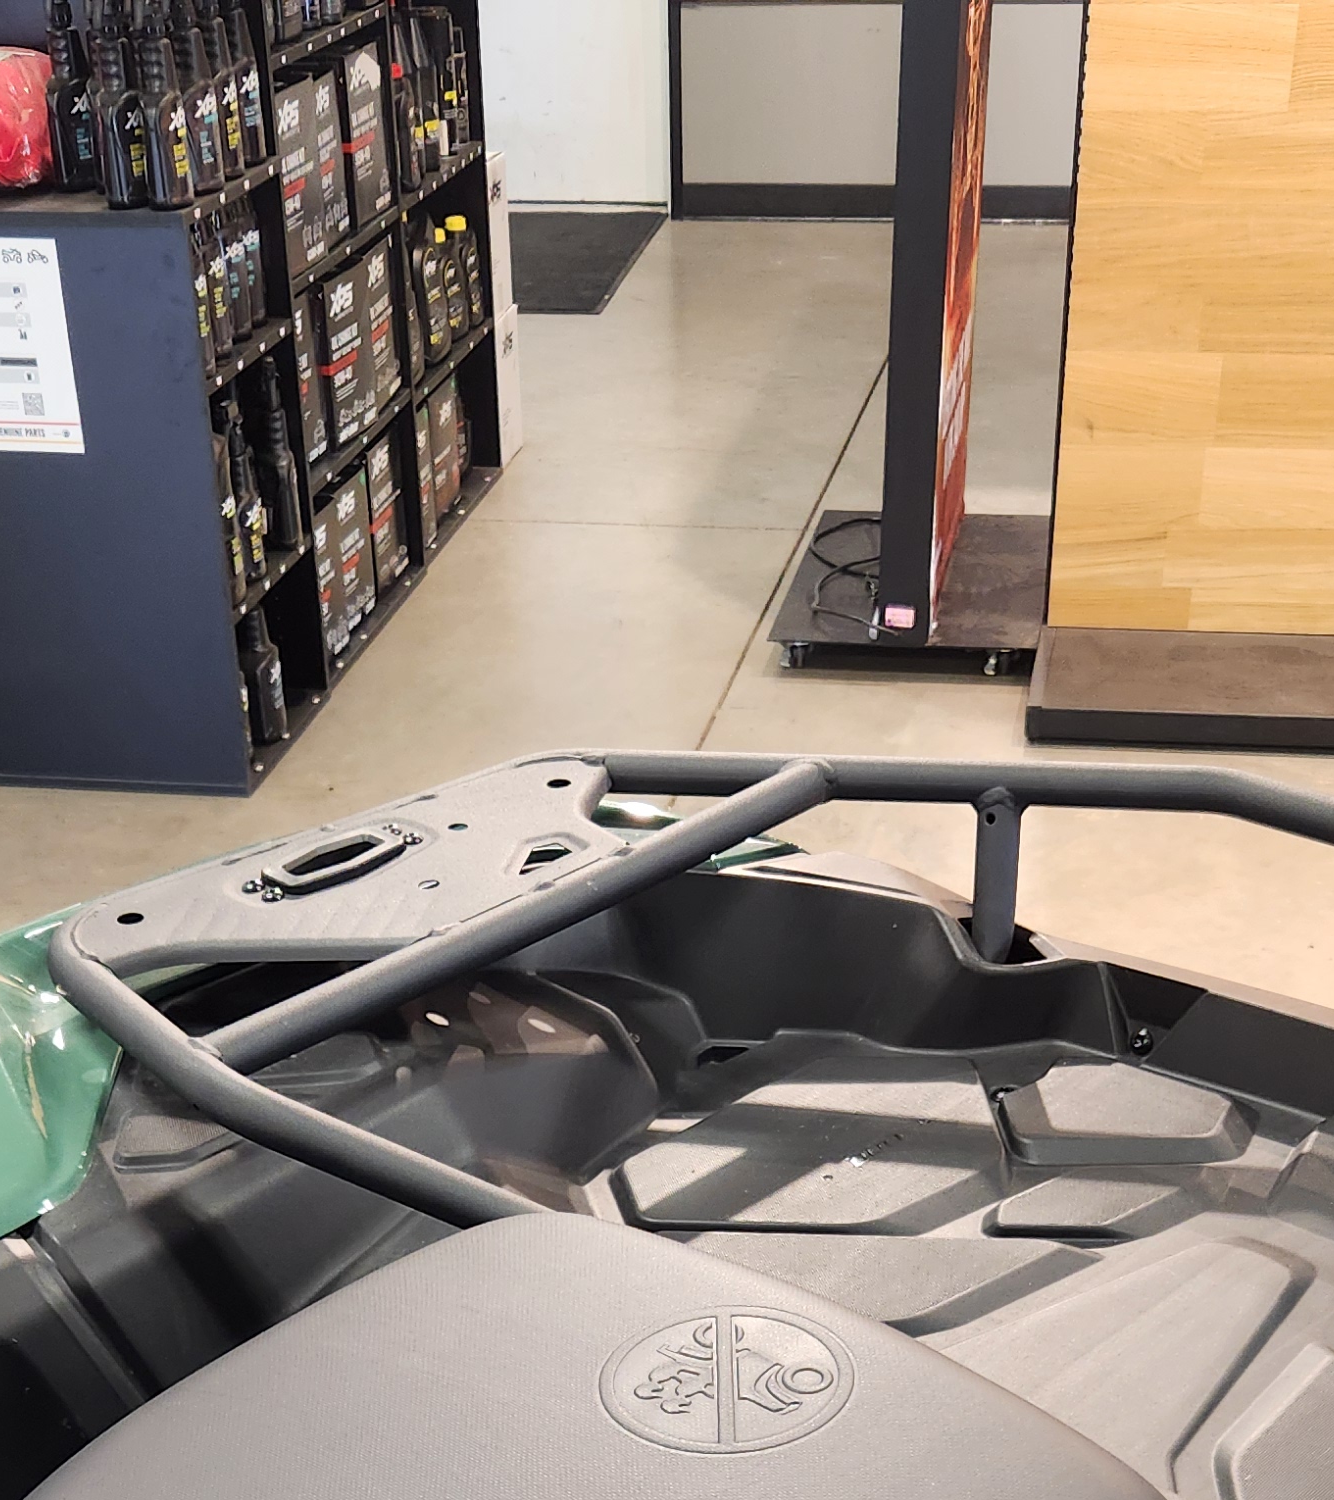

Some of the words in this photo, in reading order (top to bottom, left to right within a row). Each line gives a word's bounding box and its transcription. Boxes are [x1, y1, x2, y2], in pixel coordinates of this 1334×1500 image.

[278, 99, 299, 136] XPS
[315, 85, 329, 116] XPS
[368, 253, 385, 288] XPS
[329, 281, 354, 318] XPS
[25, 428, 46, 438] PARTS
